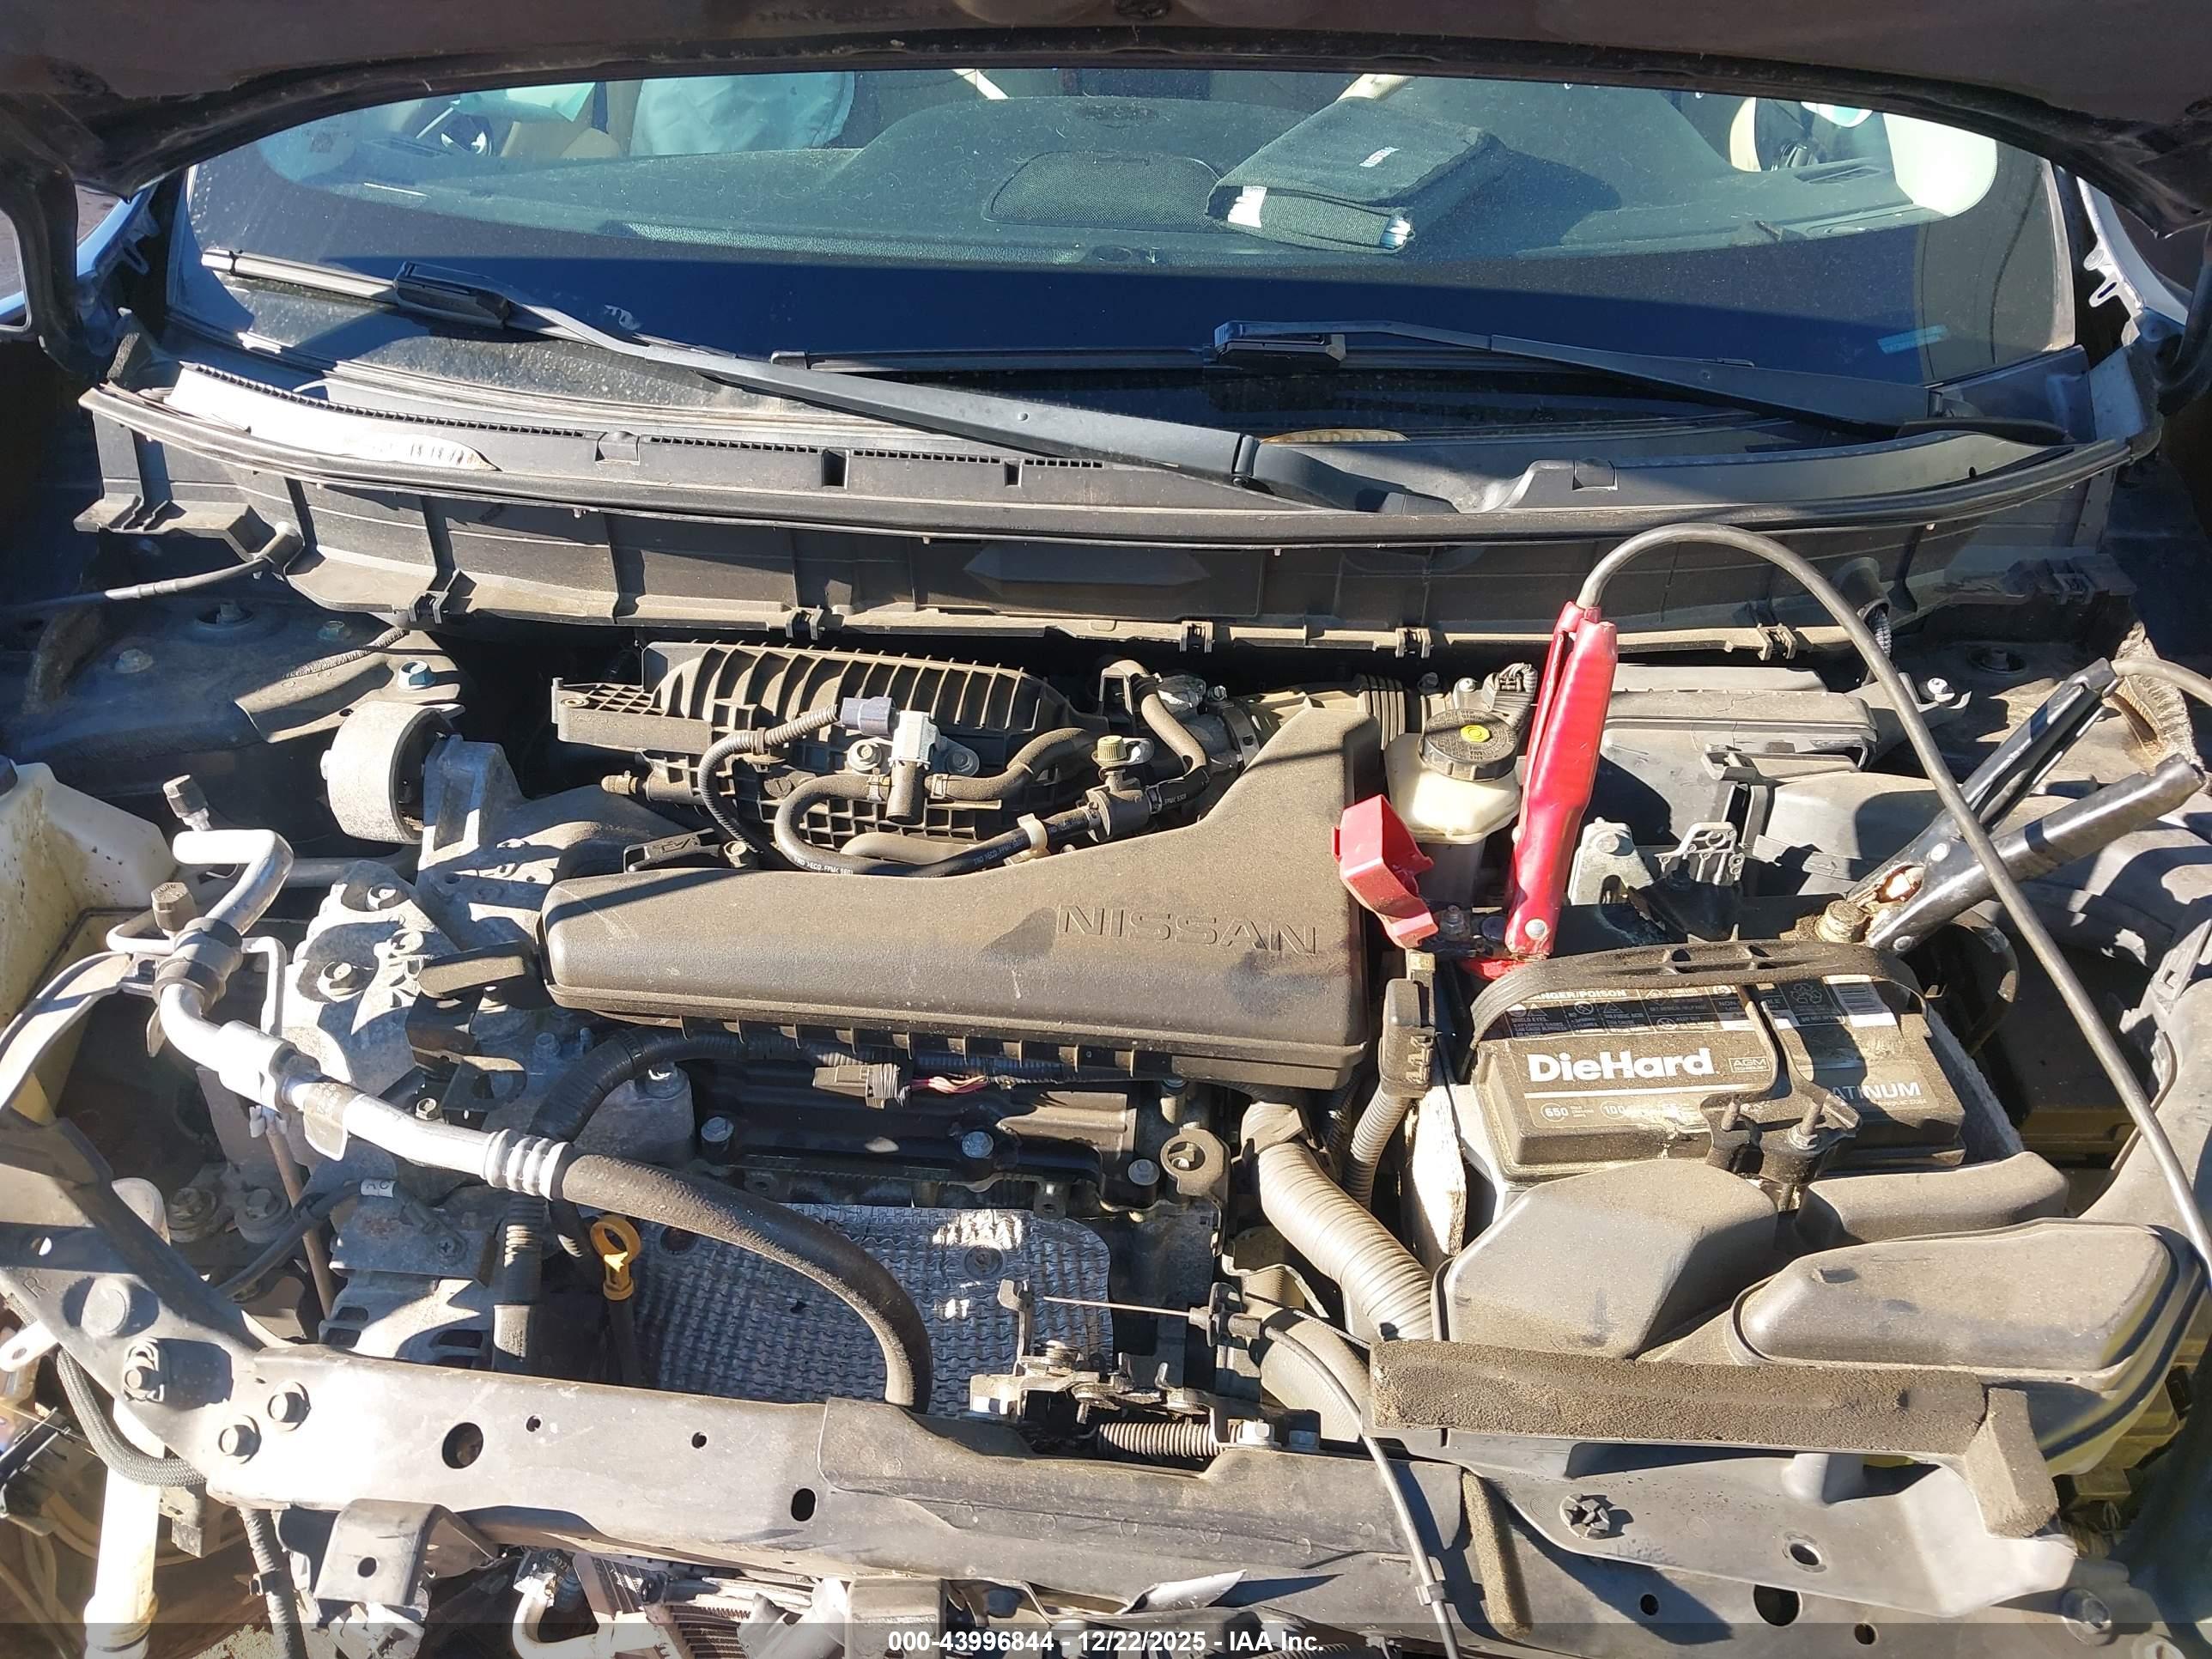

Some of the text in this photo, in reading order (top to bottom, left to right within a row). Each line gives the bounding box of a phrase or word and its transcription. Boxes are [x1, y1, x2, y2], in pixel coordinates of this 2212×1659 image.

[1057, 904, 1317, 956] NISSAN
[1527, 1048, 1714, 1082] DieHard
[1734, 1058, 1767, 1067] AGM
[1546, 1107, 1569, 1116] 650
